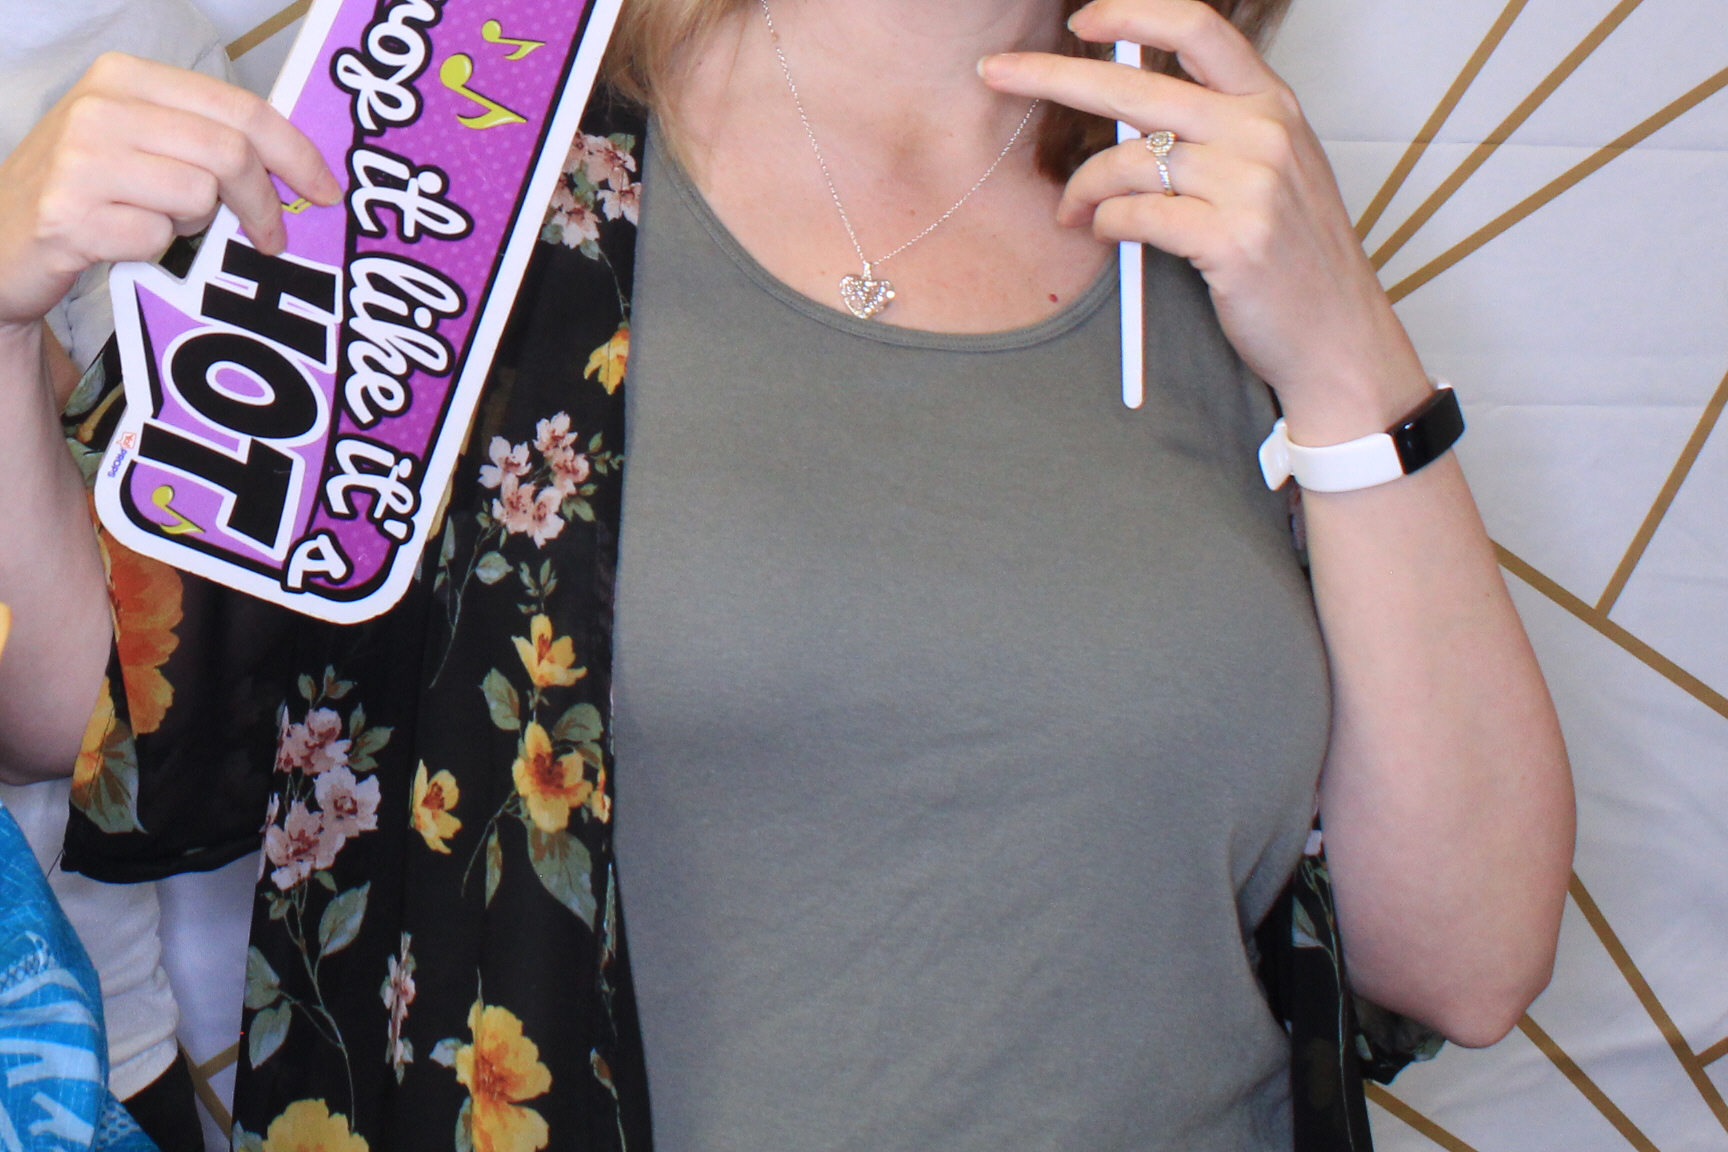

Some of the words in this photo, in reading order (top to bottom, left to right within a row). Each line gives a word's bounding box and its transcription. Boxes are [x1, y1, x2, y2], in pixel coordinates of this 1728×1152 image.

[350, 148, 469, 239] it
[137, 237, 338, 551] HOT
[344, 256, 462, 426] like
[107, 448, 128, 478] PROPS
[285, 438, 416, 590] it's
